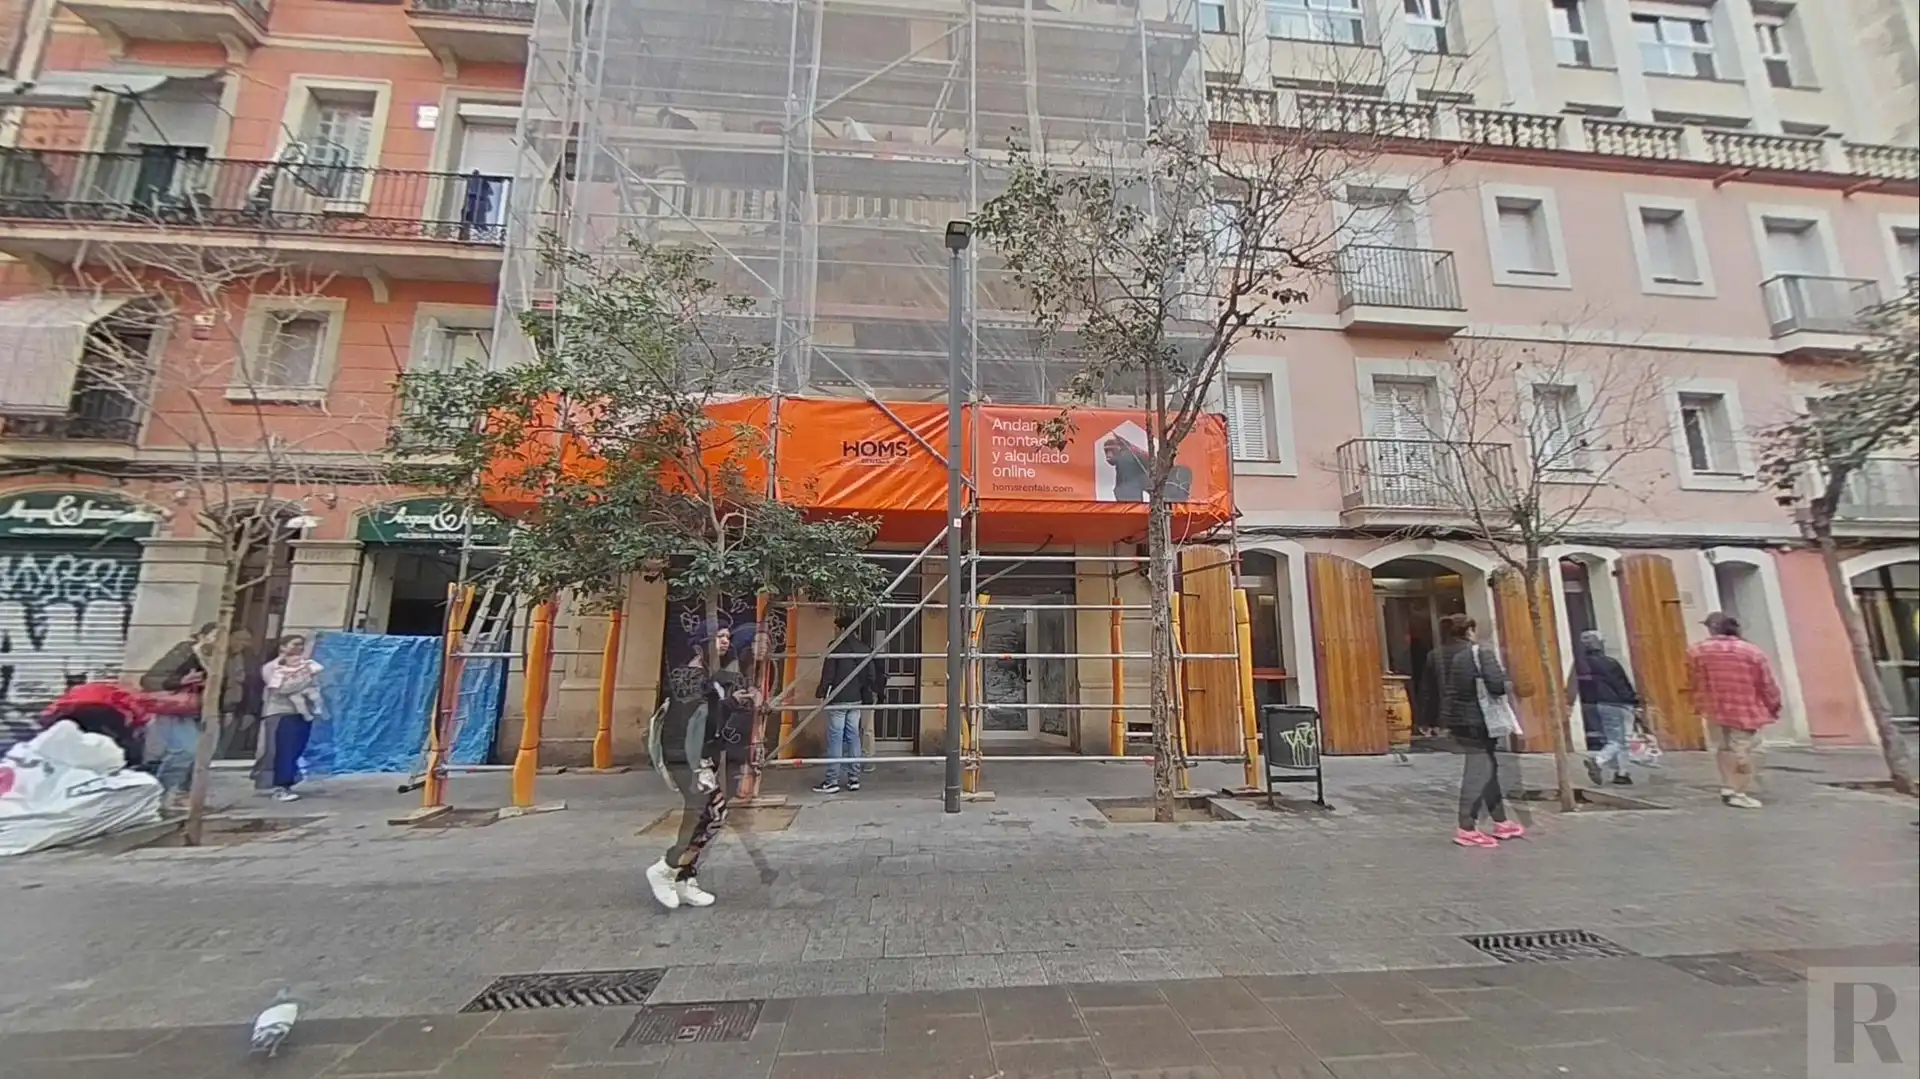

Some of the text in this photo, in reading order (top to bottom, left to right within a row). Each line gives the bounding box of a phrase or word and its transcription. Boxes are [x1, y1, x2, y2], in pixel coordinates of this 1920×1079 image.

[992, 434, 1049, 447] montad
[843, 441, 908, 457] HOMS
[992, 449, 1069, 466] y alquilado
[992, 464, 1036, 478] online
[992, 483, 1074, 493] homsrentals.com
